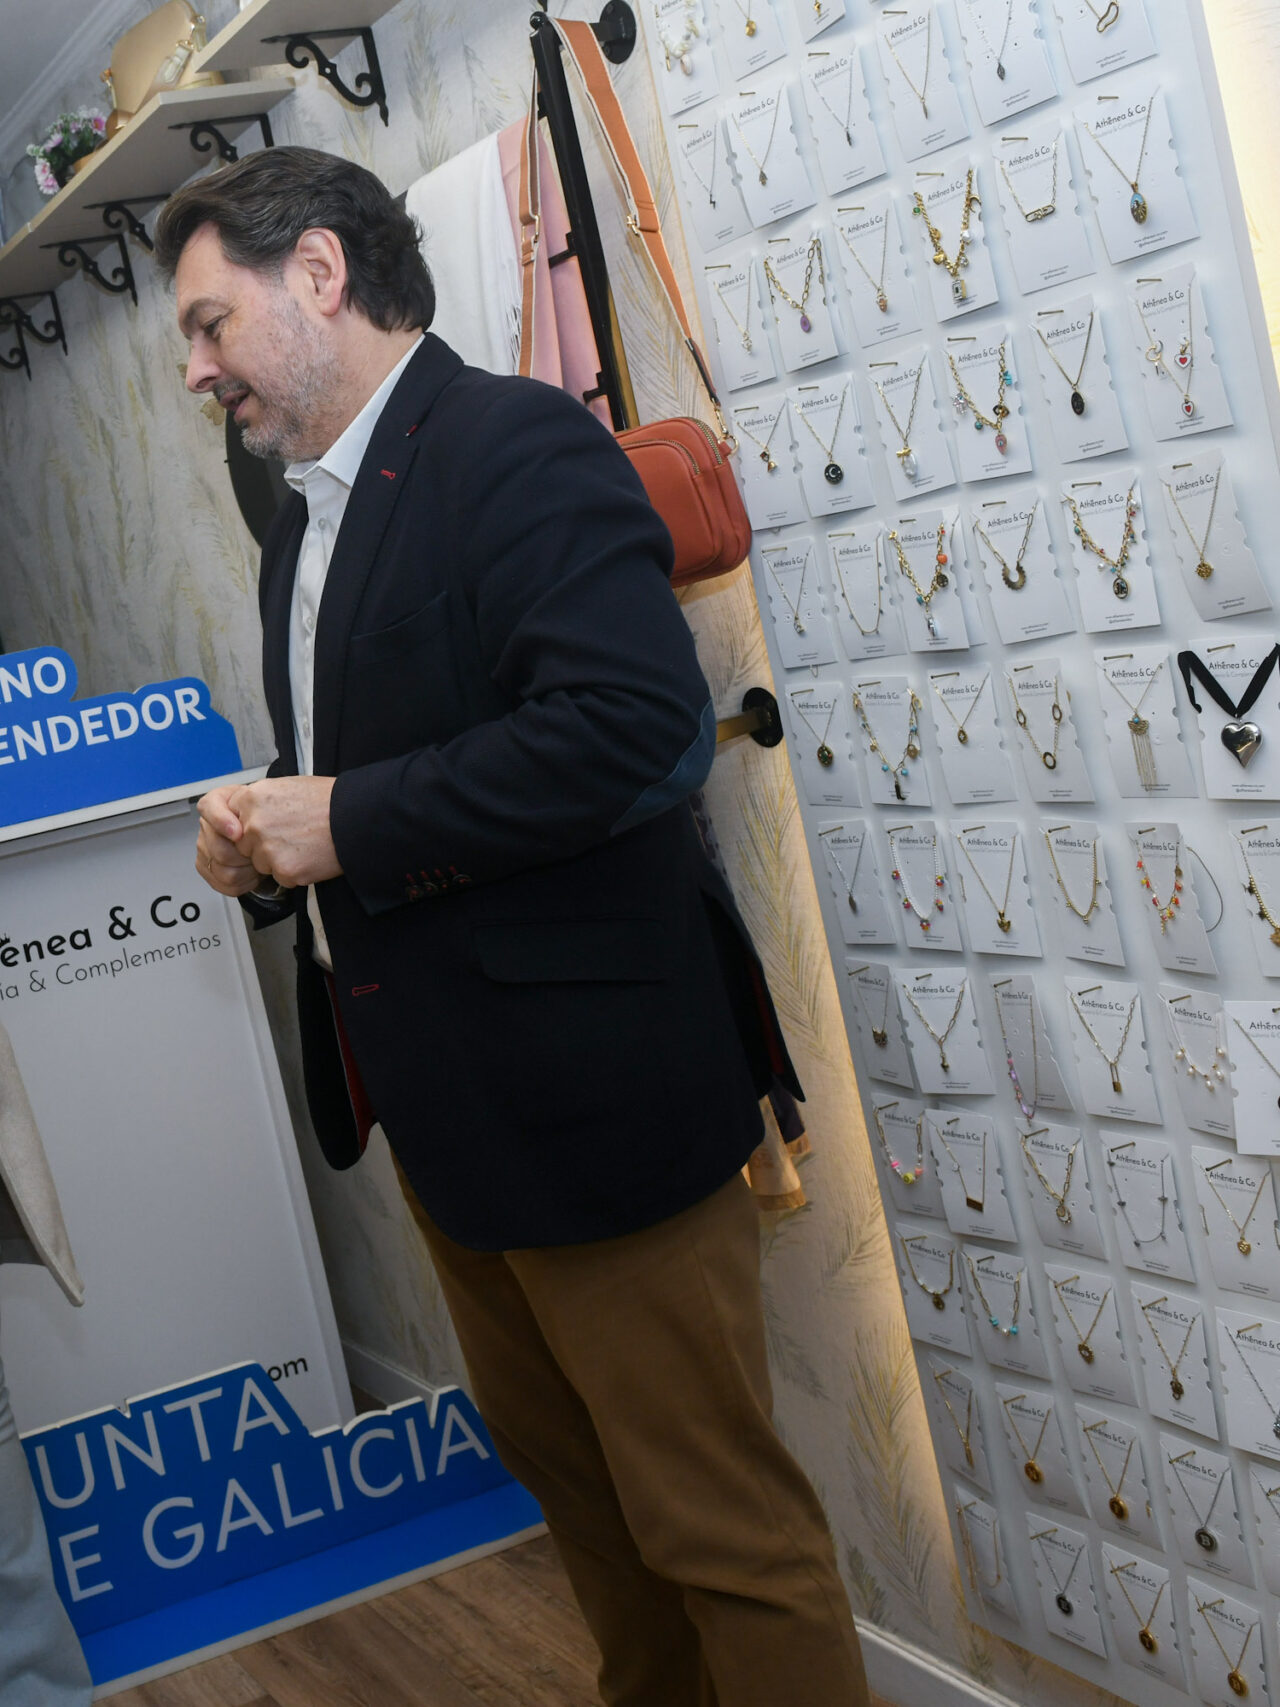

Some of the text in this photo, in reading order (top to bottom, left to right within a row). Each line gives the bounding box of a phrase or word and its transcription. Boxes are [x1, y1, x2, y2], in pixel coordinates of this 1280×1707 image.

[1136, 104, 1146, 114] Co
[1041, 146, 1050, 154] Co
[1175, 291, 1184, 299] Co
[1206, 474, 1214, 483] Co
[1114, 494, 1124, 502] Co
[1249, 658, 1260, 668] Co
[1147, 668, 1156, 677] Co
[108, 906, 136, 940] &
[150, 896, 201, 929] Co
[30, 970, 46, 992] &
[55, 933, 222, 985] Complementos
[267, 1357, 308, 1381] om
[34, 1378, 291, 1509] UNTA
[58, 1404, 491, 1602] E GALICIA
